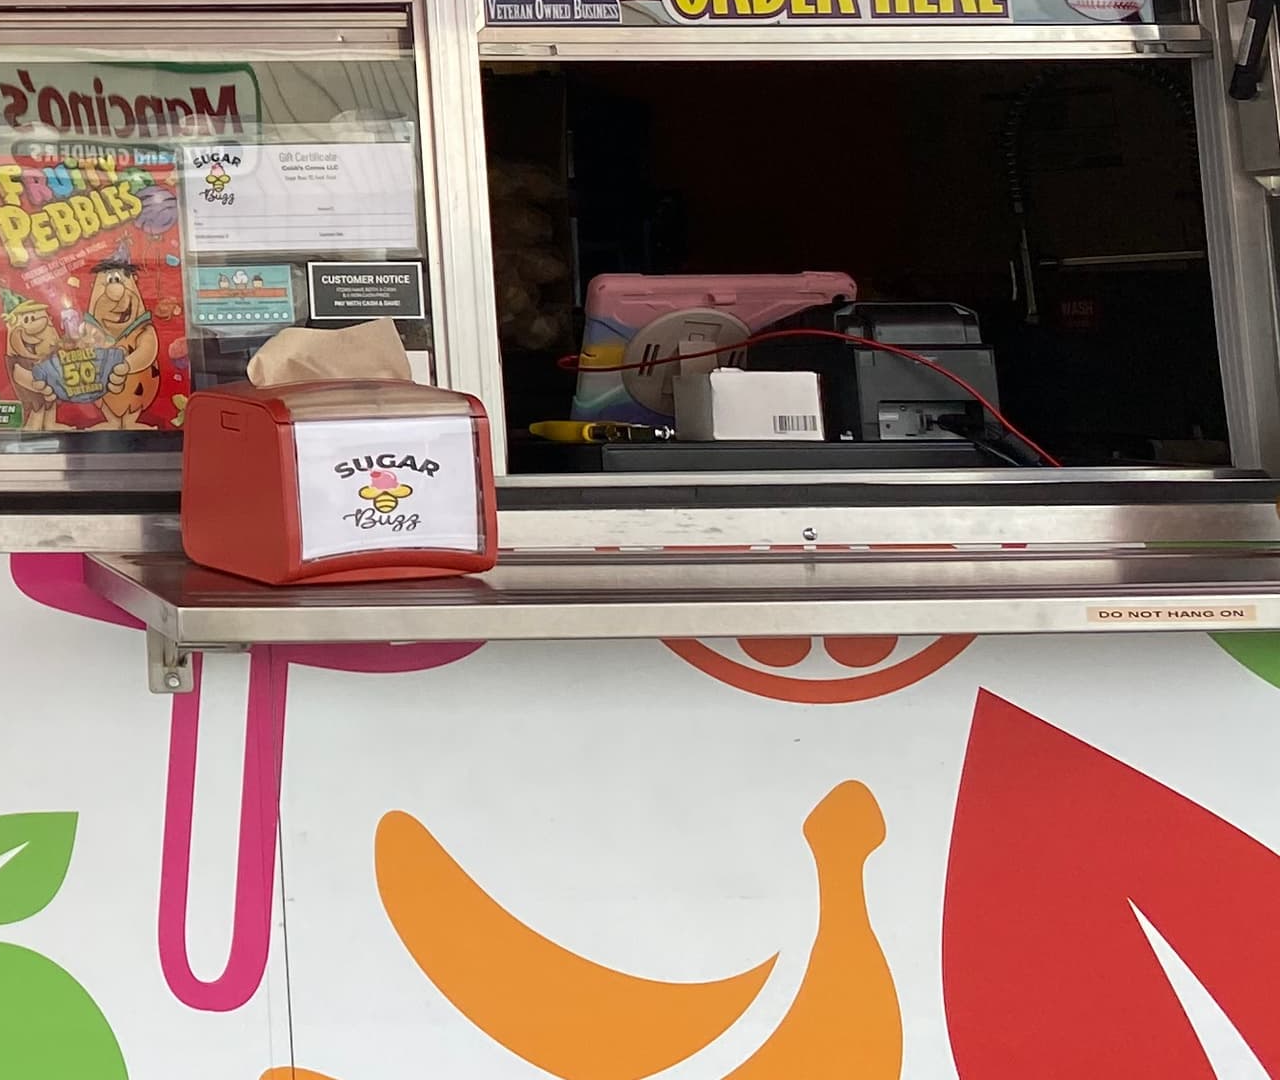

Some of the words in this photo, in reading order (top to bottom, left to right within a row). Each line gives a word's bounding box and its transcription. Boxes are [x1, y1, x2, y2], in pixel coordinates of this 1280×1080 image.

[193, 151, 242, 169] SUGAR
[279, 151, 293, 162] Gift
[295, 151, 337, 162] Certificate
[199, 189, 235, 205] Buzz
[321, 274, 374, 284] CUSTOMER
[375, 274, 411, 284] NOTICE
[1061, 301, 1094, 315] WASH
[334, 453, 440, 479] SUGAR
[342, 507, 422, 532] Buzz
[1098, 610, 1123, 619] DO
[1128, 610, 1163, 618] NOT
[1167, 609, 1215, 618] HANG
[1220, 609, 1245, 618] ON
